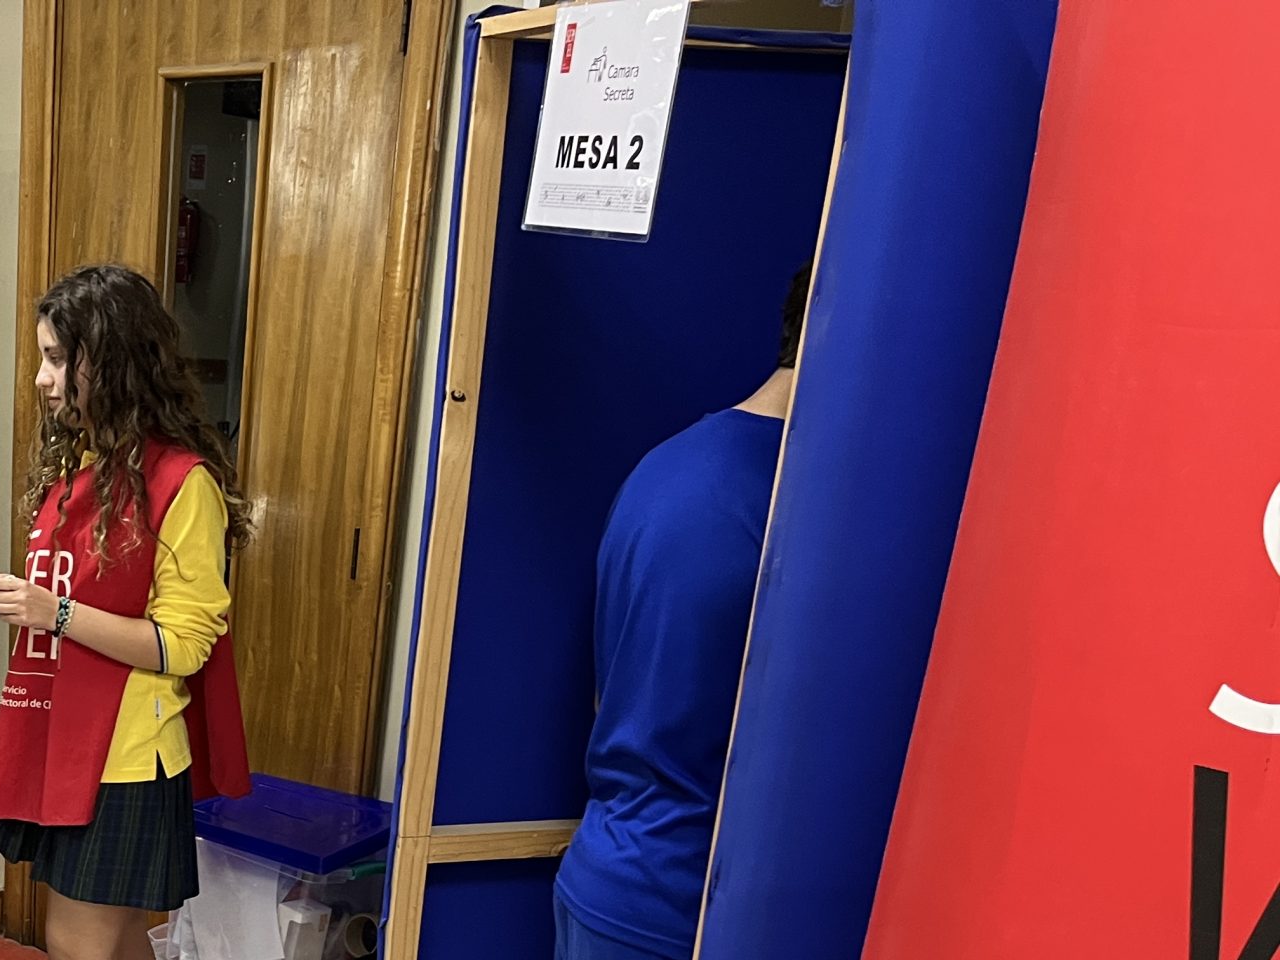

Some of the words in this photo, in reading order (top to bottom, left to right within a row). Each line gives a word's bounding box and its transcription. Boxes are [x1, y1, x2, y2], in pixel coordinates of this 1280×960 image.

[607, 63, 640, 79] Camara
[603, 84, 634, 101] Secreta
[556, 135, 618, 169] MESA
[626, 135, 644, 170] 2
[25, 549, 74, 598] ER
